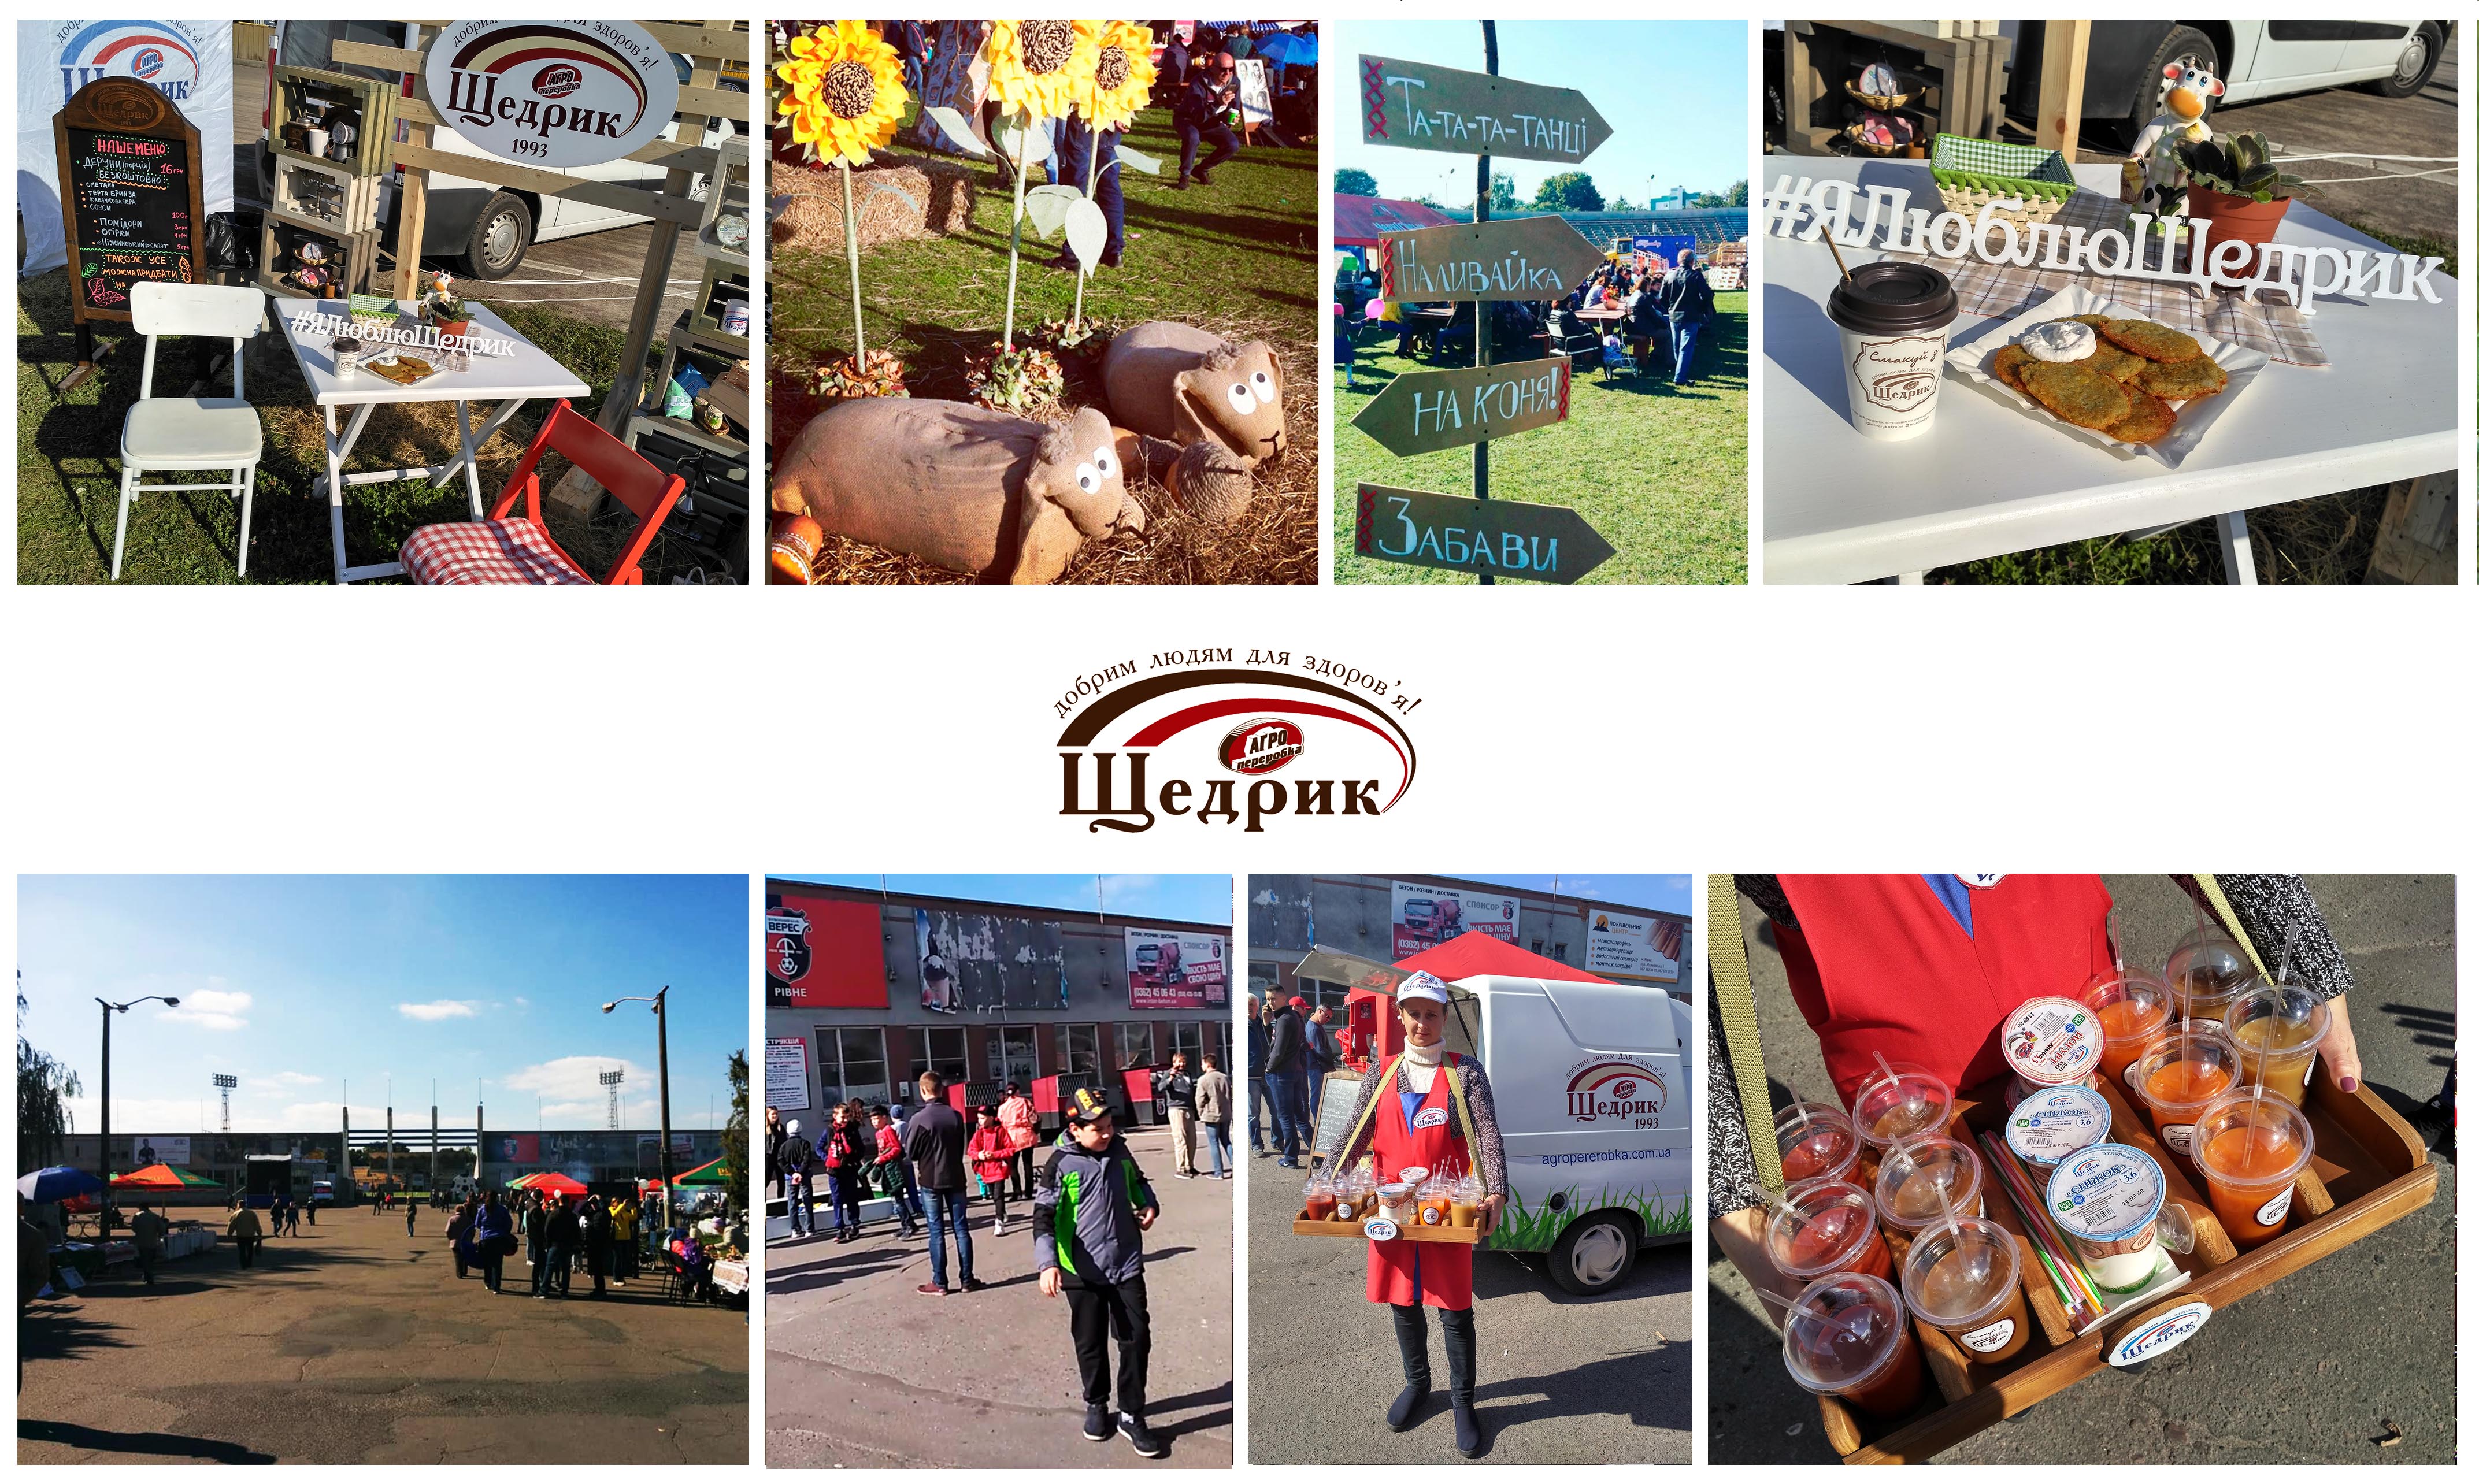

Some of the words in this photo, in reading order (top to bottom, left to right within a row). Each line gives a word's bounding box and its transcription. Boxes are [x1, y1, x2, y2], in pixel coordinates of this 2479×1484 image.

[166, 20, 203, 46] доров'я!
[592, 20, 660, 71] здоров'я!
[141, 52, 158, 68] АГРО
[547, 69, 574, 86] АГРО
[538, 83, 581, 96] переробка
[446, 71, 621, 139] Щедрик
[98, 139, 134, 154] НАШЕ
[135, 143, 165, 155] МЕНЮ
[512, 139, 548, 158] 1993
[83, 157, 121, 169] ДЕРУНИ
[123, 159, 151, 172] (порція)
[100, 218, 142, 229] Помідори
[102, 228, 130, 238] Огірки
[1763, 174, 2444, 316] #ЯЛюблюЩедрик
[105, 254, 143, 264] ТАКОЖ
[149, 256, 166, 264] УСЕ
[136, 269, 178, 279] ПРИДБАТИ
[290, 310, 516, 360] #ЯЛюблюЩедрик
[1870, 350, 1929, 368] Смакуй
[1872, 372, 1888, 380] добрим
[1873, 385, 1930, 401] Щедрик
[1413, 390, 1462, 436] НА
[1472, 366, 1558, 425] КОНЯ!
[1466, 900, 1499, 911] СПОНСОР
[769, 922, 800, 932] ВЕРЕС
[1495, 925, 1511, 933] МАЄ
[1610, 921, 1642, 930] ПОКРІВЕЛЬНИЙ
[1398, 939, 1420, 951] (0362)
[1597, 938, 1631, 947] металопрофіль
[1596, 946, 1633, 955] металочерепиця
[1188, 974, 1207, 983] СВОЮ
[775, 988, 807, 997] РІВНЕ
[1153, 988, 1160, 996] 45
[1169, 988, 1176, 997] 43
[2077, 1016, 2085, 1025] БЕЗ
[2039, 1043, 2054, 1059] АНАНАС
[2049, 1030, 2085, 1065] ЙОГУРТ
[2067, 1045, 2087, 1062] Щедрик
[1565, 1059, 1589, 1079] добрим
[1592, 1054, 1615, 1062] людям
[1636, 1058, 1667, 1079] здоров'я!
[2055, 1061, 2063, 1070] 4343
[2059, 1062, 2067, 1072] ДСТУ
[1567, 1093, 1658, 1122] Щедрик
[2030, 1108, 2091, 1118] «СНІЖОК»
[1417, 1118, 1442, 1127] Щедрик
[1635, 1118, 1659, 1129] 1993
[1542, 1149, 1671, 1167] agropererobka.com.ua
[2073, 1163, 2100, 1178] Щедрик
[2123, 1171, 2137, 1182] 3,6
[2066, 1164, 2126, 1197] «СНІЖОК»
[2086, 1179, 2118, 1197] кисломолочний
[2090, 1184, 2118, 1199] термостатний
[1966, 1327, 1997, 1338] Смакуй
[2118, 1335, 2136, 1351] добрим
[2139, 1322, 2158, 1334] людям
[2180, 1326, 2196, 1335] 1993
[1972, 1335, 2006, 1347] Щедрик
[2122, 1321, 2195, 1360] Щедрик
